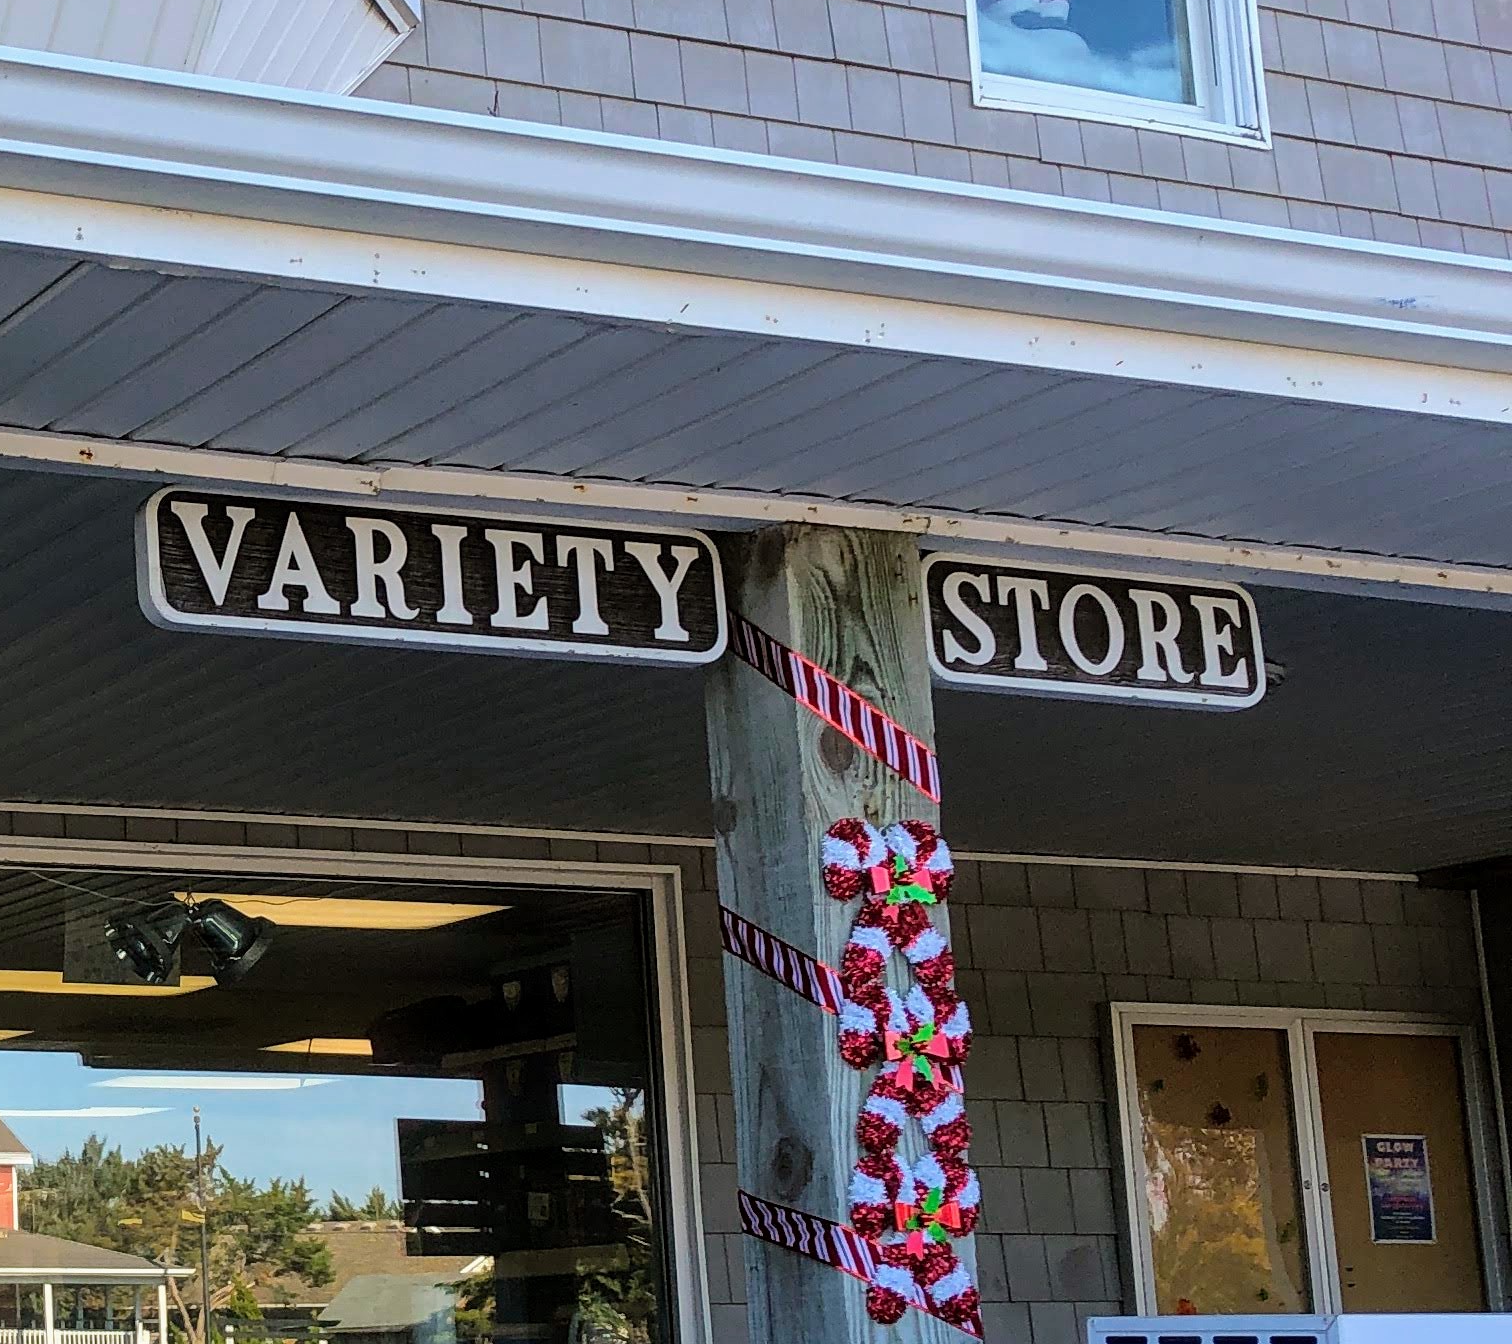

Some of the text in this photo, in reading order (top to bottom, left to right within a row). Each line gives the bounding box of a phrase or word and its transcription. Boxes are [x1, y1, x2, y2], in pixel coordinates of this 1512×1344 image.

[170, 500, 700, 642] VARIETY
[942, 571, 1249, 688] STORE
[1376, 1141, 1414, 1153] GLOW
